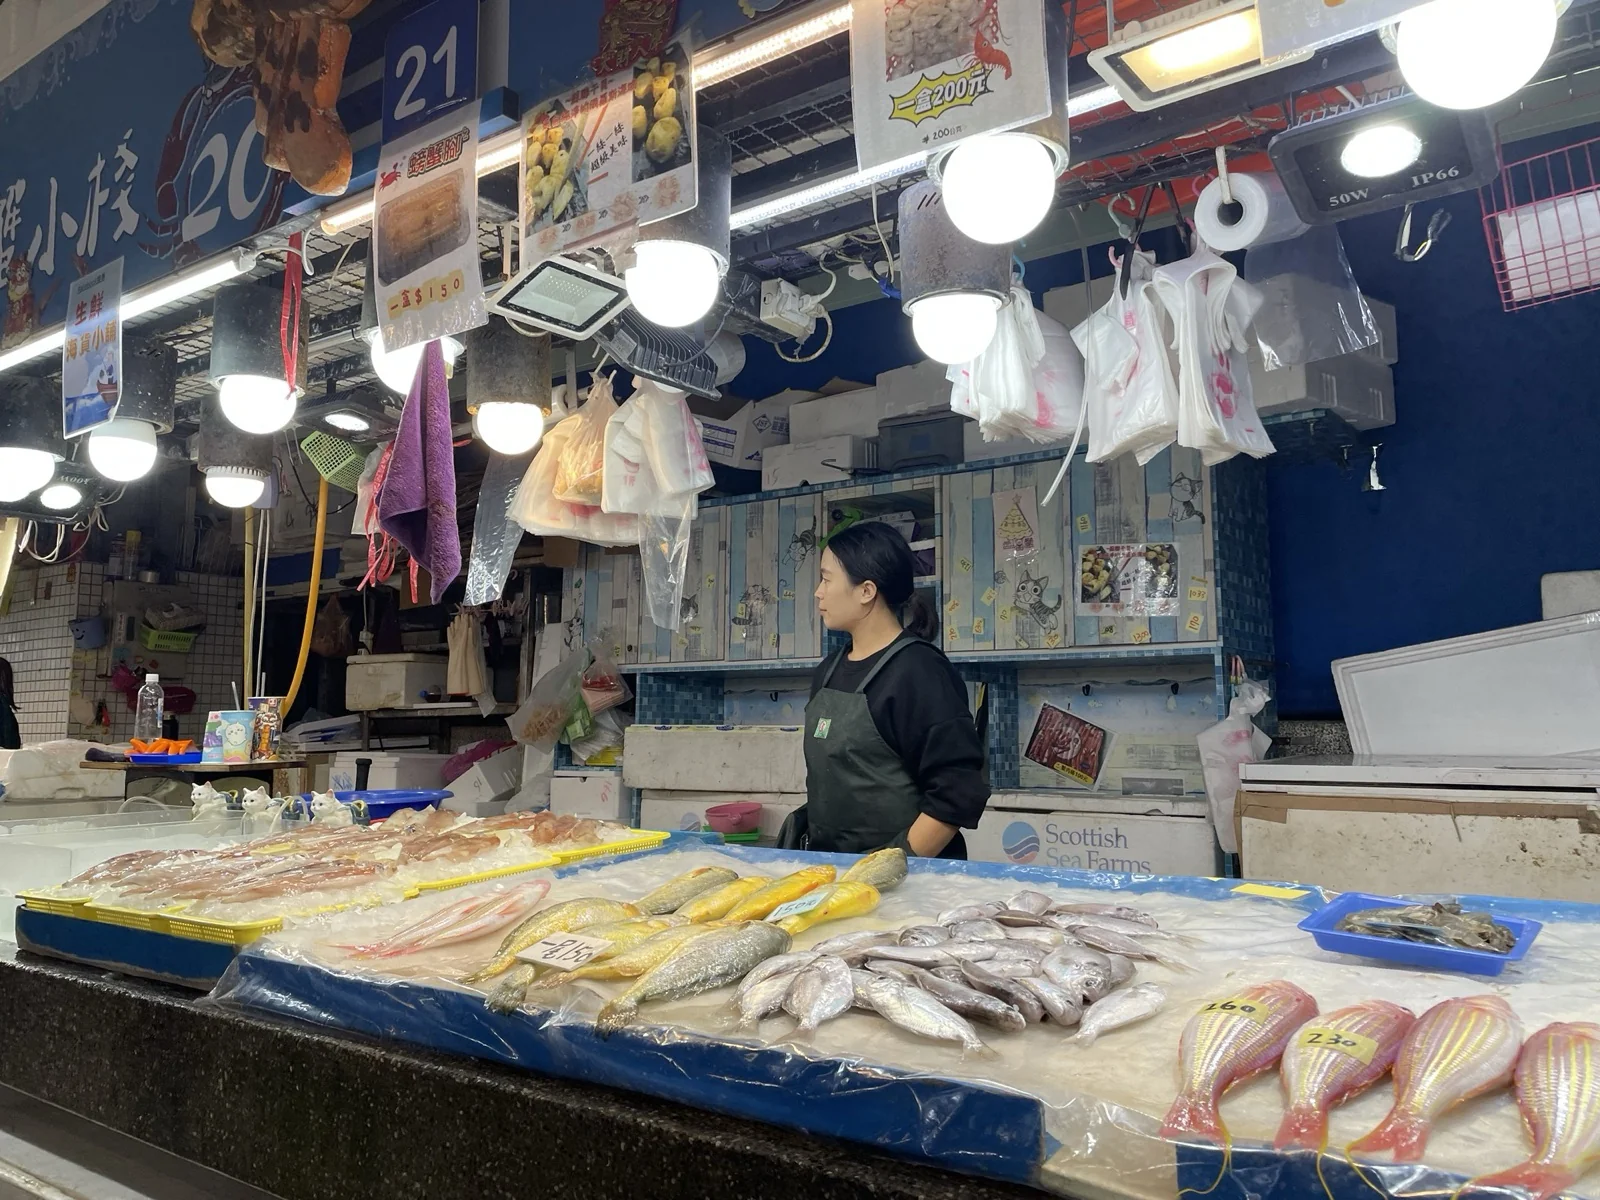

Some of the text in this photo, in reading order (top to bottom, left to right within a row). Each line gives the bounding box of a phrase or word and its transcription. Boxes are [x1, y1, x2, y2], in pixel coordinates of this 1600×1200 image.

[394, 26, 457, 121] 21
[897, 67, 986, 115] 一盒200元
[1329, 165, 1460, 207] 50W IP66
[75, 290, 104, 326] 生鮮
[1045, 823, 1129, 849] Scottish
[1046, 847, 1151, 874] Sea Farms
[1307, 1033, 1357, 1047] 230
